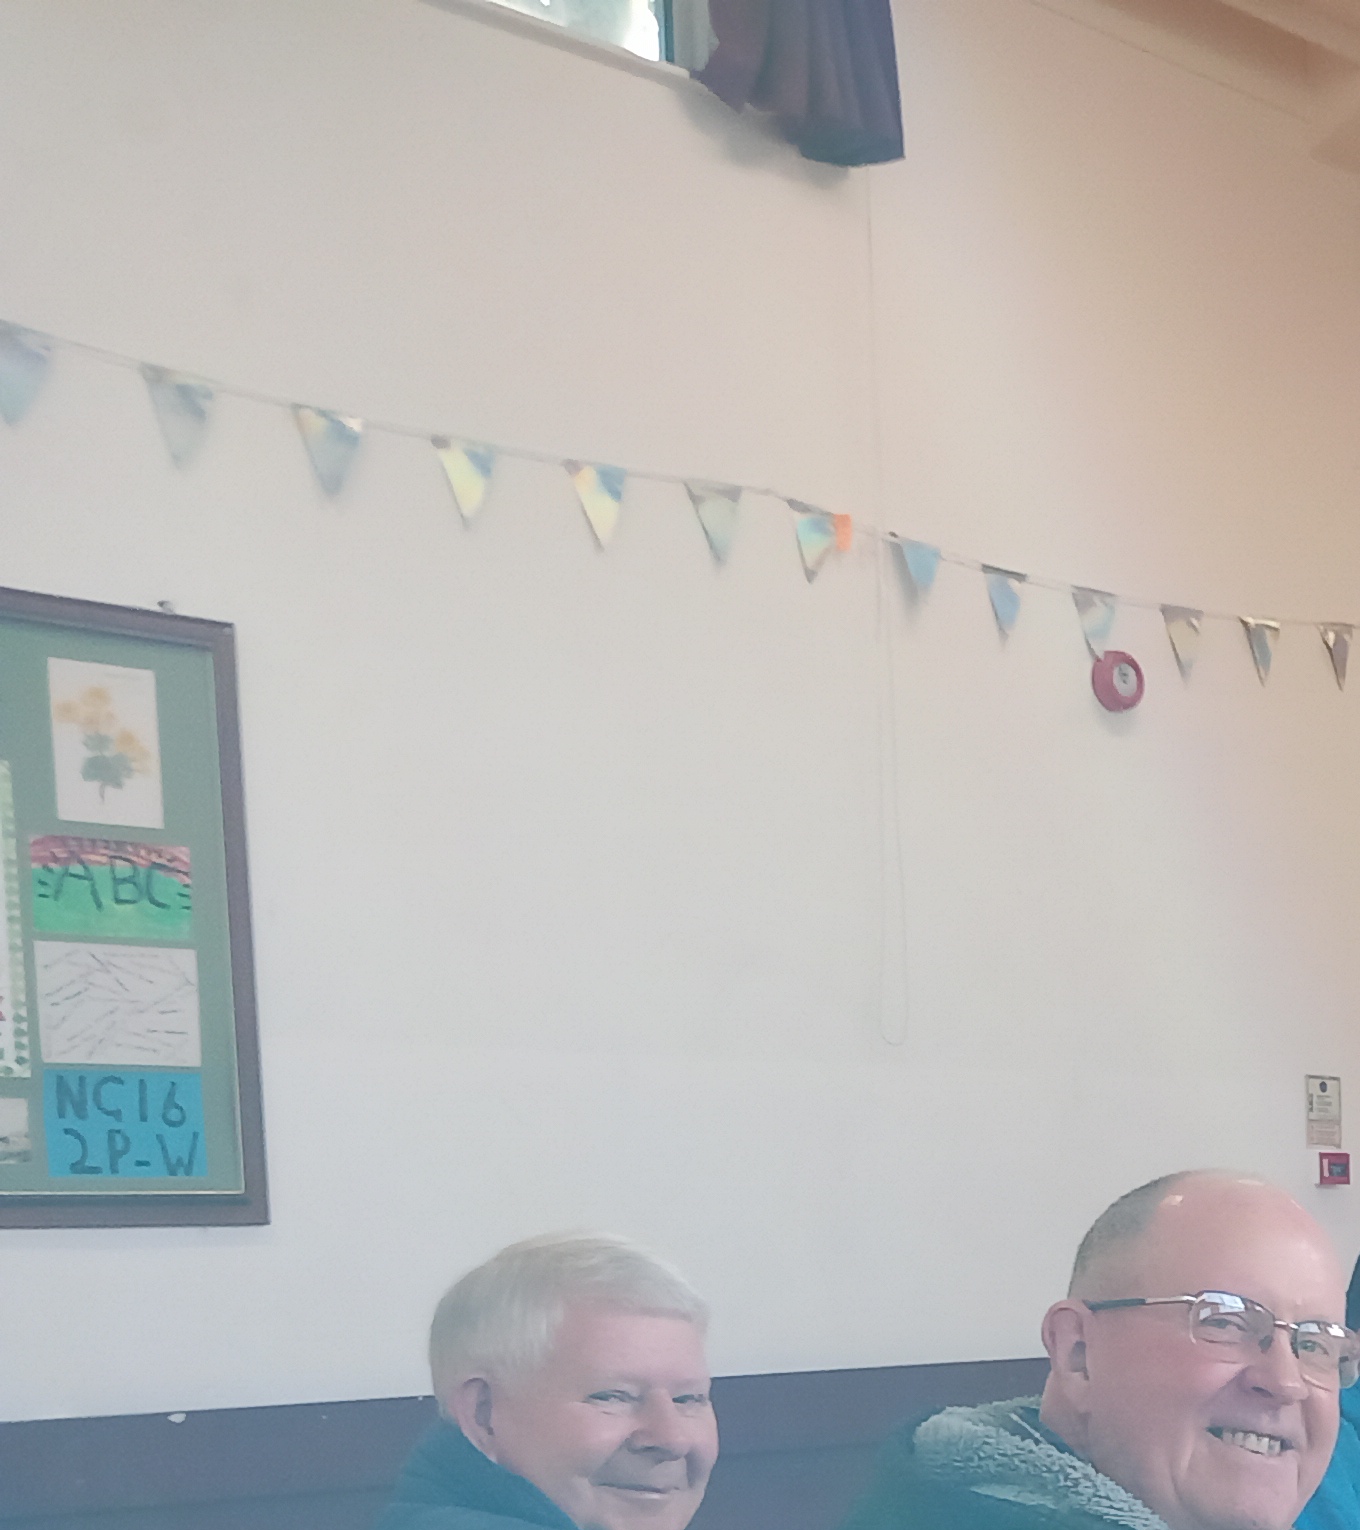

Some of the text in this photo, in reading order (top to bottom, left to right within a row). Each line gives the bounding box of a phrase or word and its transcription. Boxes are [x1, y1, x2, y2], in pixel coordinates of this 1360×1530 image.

[50, 849, 190, 913] ABC
[55, 1074, 187, 1128] NC16
[62, 1127, 200, 1177] 2P-W
